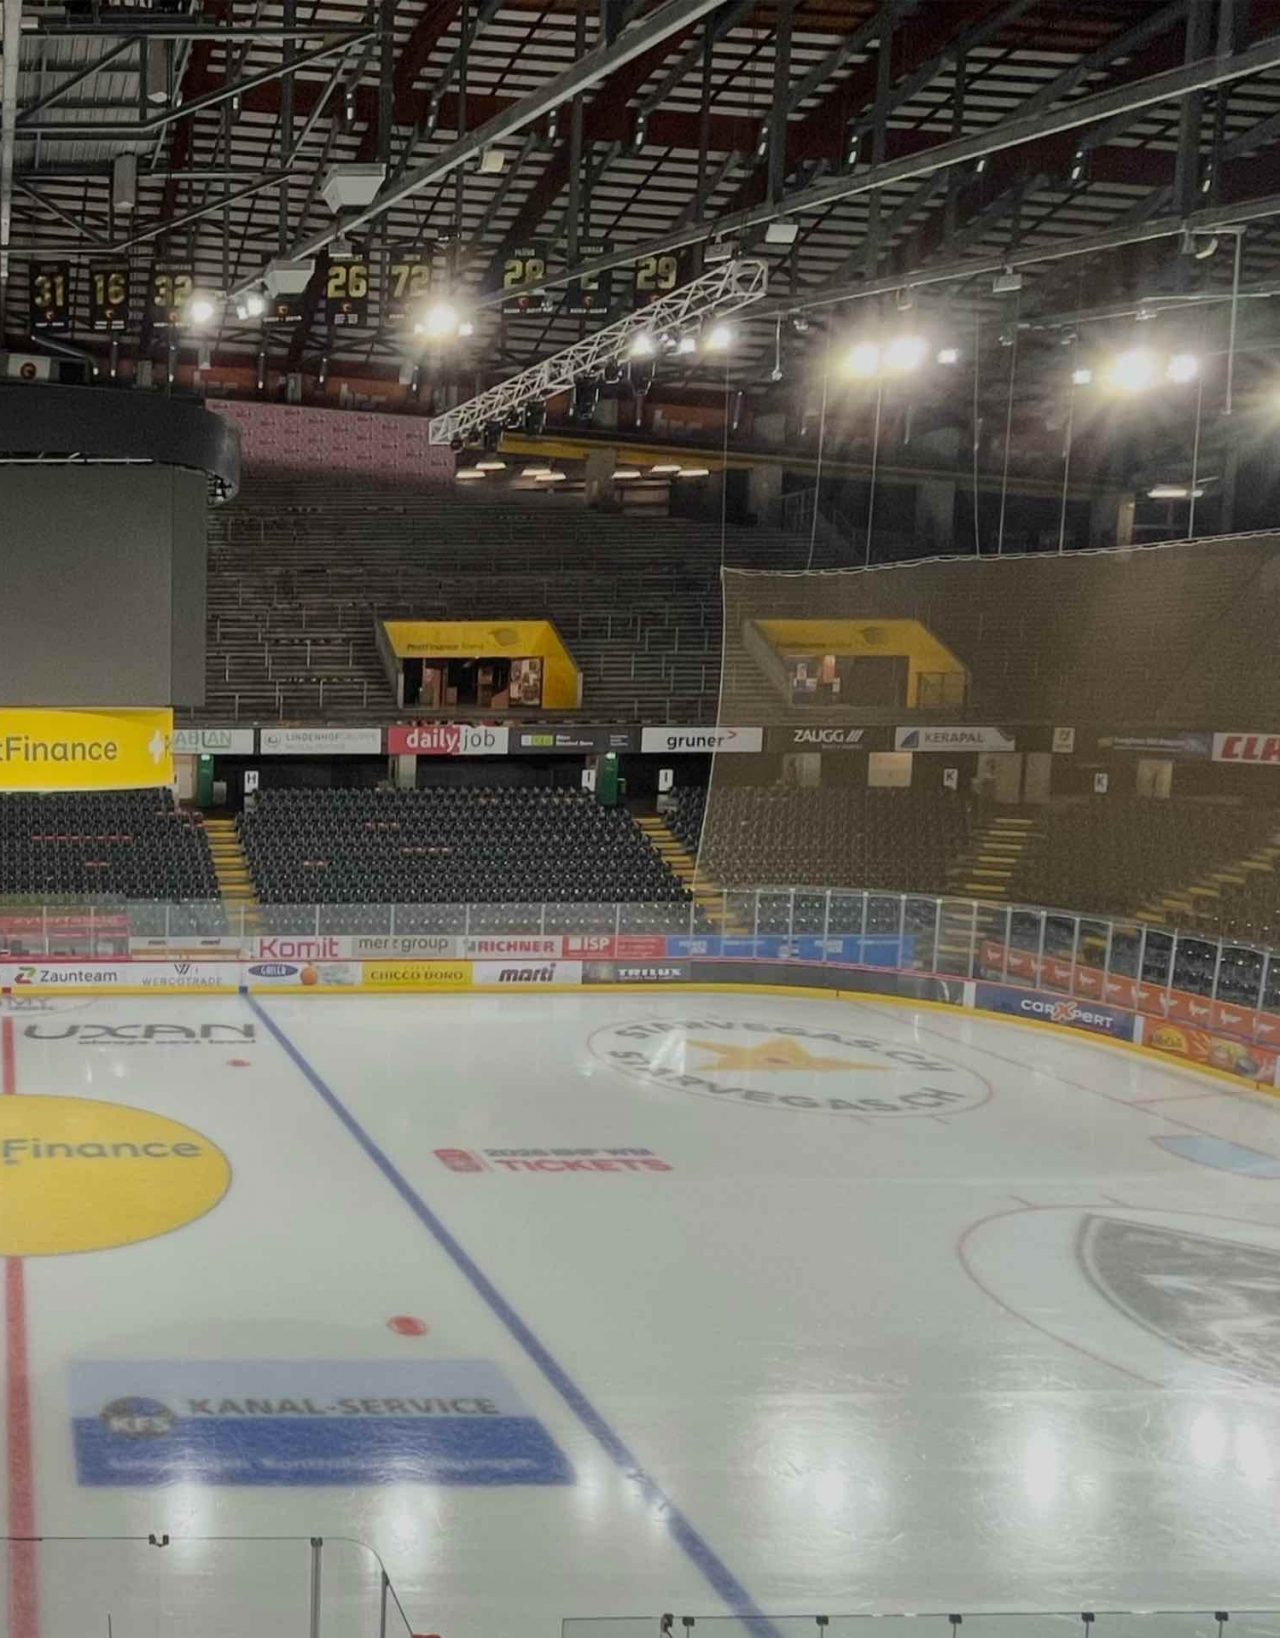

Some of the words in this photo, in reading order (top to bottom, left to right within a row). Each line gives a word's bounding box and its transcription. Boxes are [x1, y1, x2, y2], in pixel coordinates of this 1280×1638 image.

[637, 257, 677, 289] 29
[327, 265, 367, 298] 26
[391, 265, 430, 297] 72
[667, 735, 725, 750] gruner
[794, 729, 844, 743] ZAUGG
[247, 774, 256, 785] H
[946, 772, 955, 783] K
[1096, 776, 1104, 789] K
[260, 938, 339, 957] Komit
[478, 941, 554, 952] RICHNER
[584, 938, 609, 950] ISP
[41, 970, 117, 983] Zaunteam
[370, 971, 420, 980] CHICCO
[499, 963, 556, 982] marti
[619, 969, 681, 977] TRILUX
[24, 1023, 255, 1040] UXAN
[494, 1159, 674, 1172] TICKETS
[187, 1398, 501, 1416] KANAL-SERVICE
